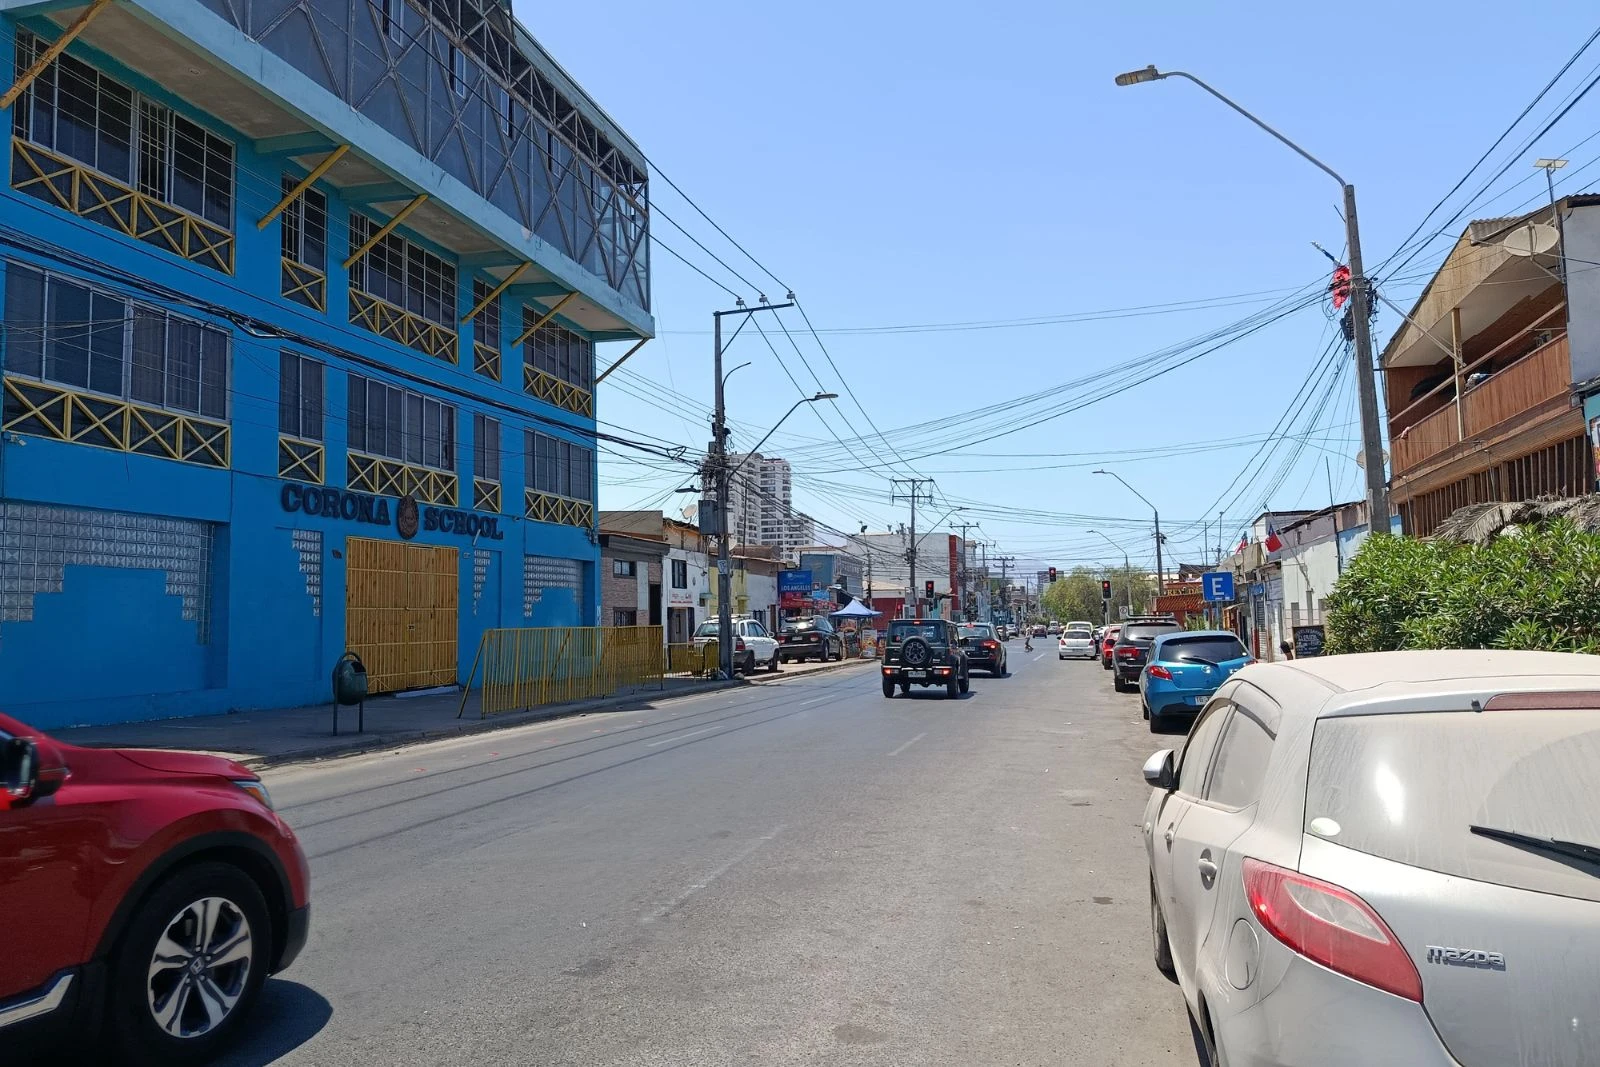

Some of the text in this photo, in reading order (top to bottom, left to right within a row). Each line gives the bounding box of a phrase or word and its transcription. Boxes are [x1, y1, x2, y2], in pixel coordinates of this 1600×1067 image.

[281, 483, 504, 540] CORONA SCHOOL
[1211, 577, 1225, 596] E
